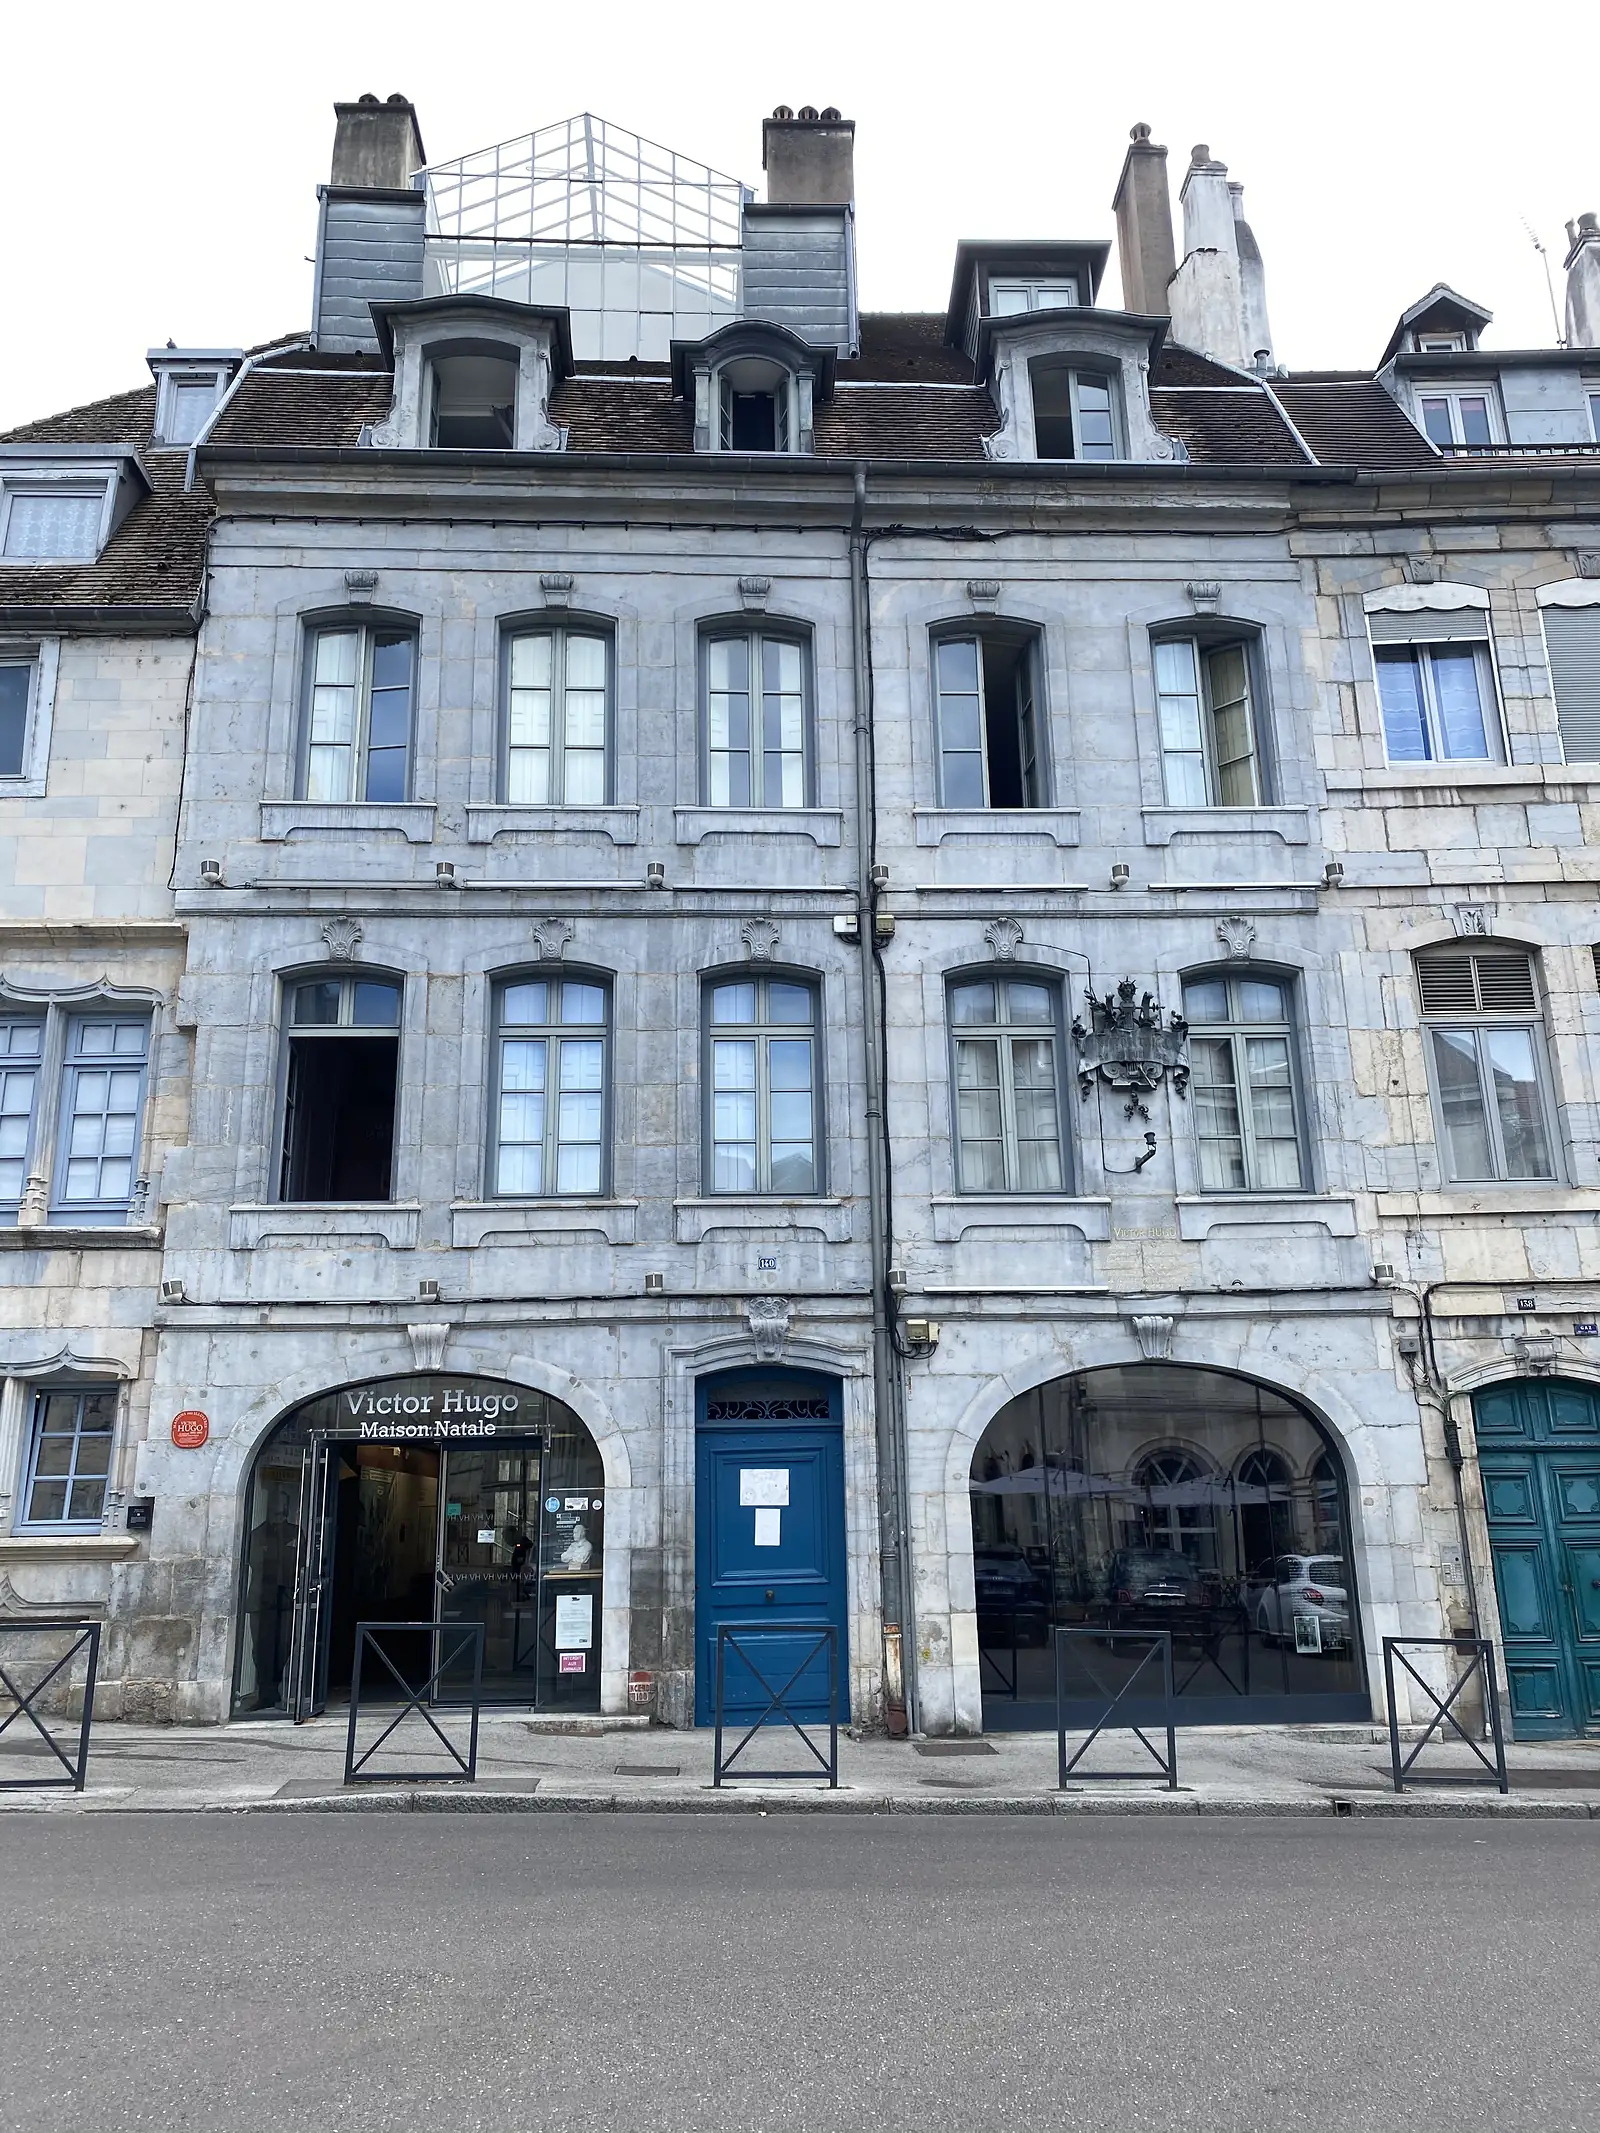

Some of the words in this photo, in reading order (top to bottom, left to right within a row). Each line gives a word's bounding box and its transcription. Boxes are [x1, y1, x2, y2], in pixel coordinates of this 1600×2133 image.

[1148, 1227, 1177, 1237] HUGO
[761, 1259, 774, 1268] 140
[1519, 1299, 1534, 1308] 138
[344, 1390, 434, 1414] Victor
[442, 1389, 519, 1419] Hugo
[178, 1424, 203, 1432] HUGO
[360, 1421, 432, 1438] Maison
[434, 1419, 496, 1437] Natale
[483, 1573, 495, 1581] VH
